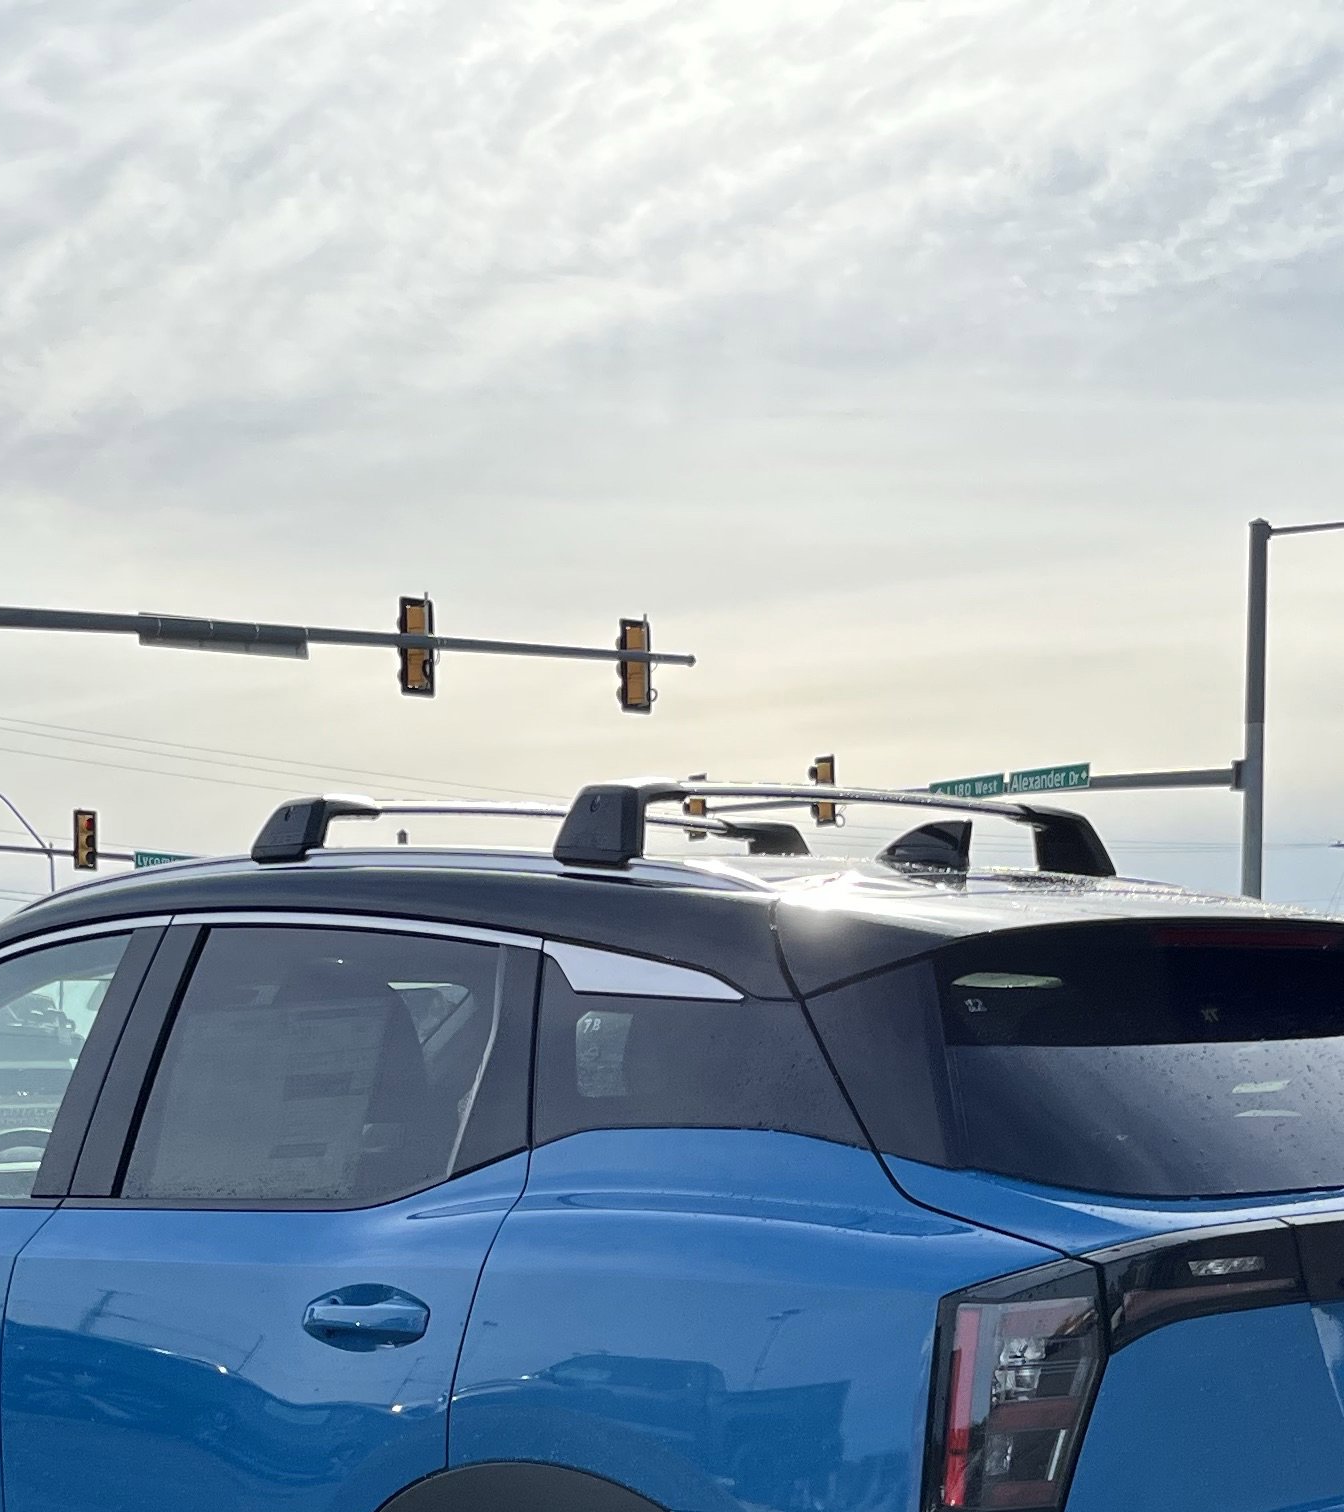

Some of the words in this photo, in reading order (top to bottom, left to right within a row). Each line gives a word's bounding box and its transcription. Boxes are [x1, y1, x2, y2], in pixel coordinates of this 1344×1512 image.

[975, 780, 998, 794] West
[1011, 770, 1066, 792] Alexander
[1068, 771, 1080, 786] Dr
